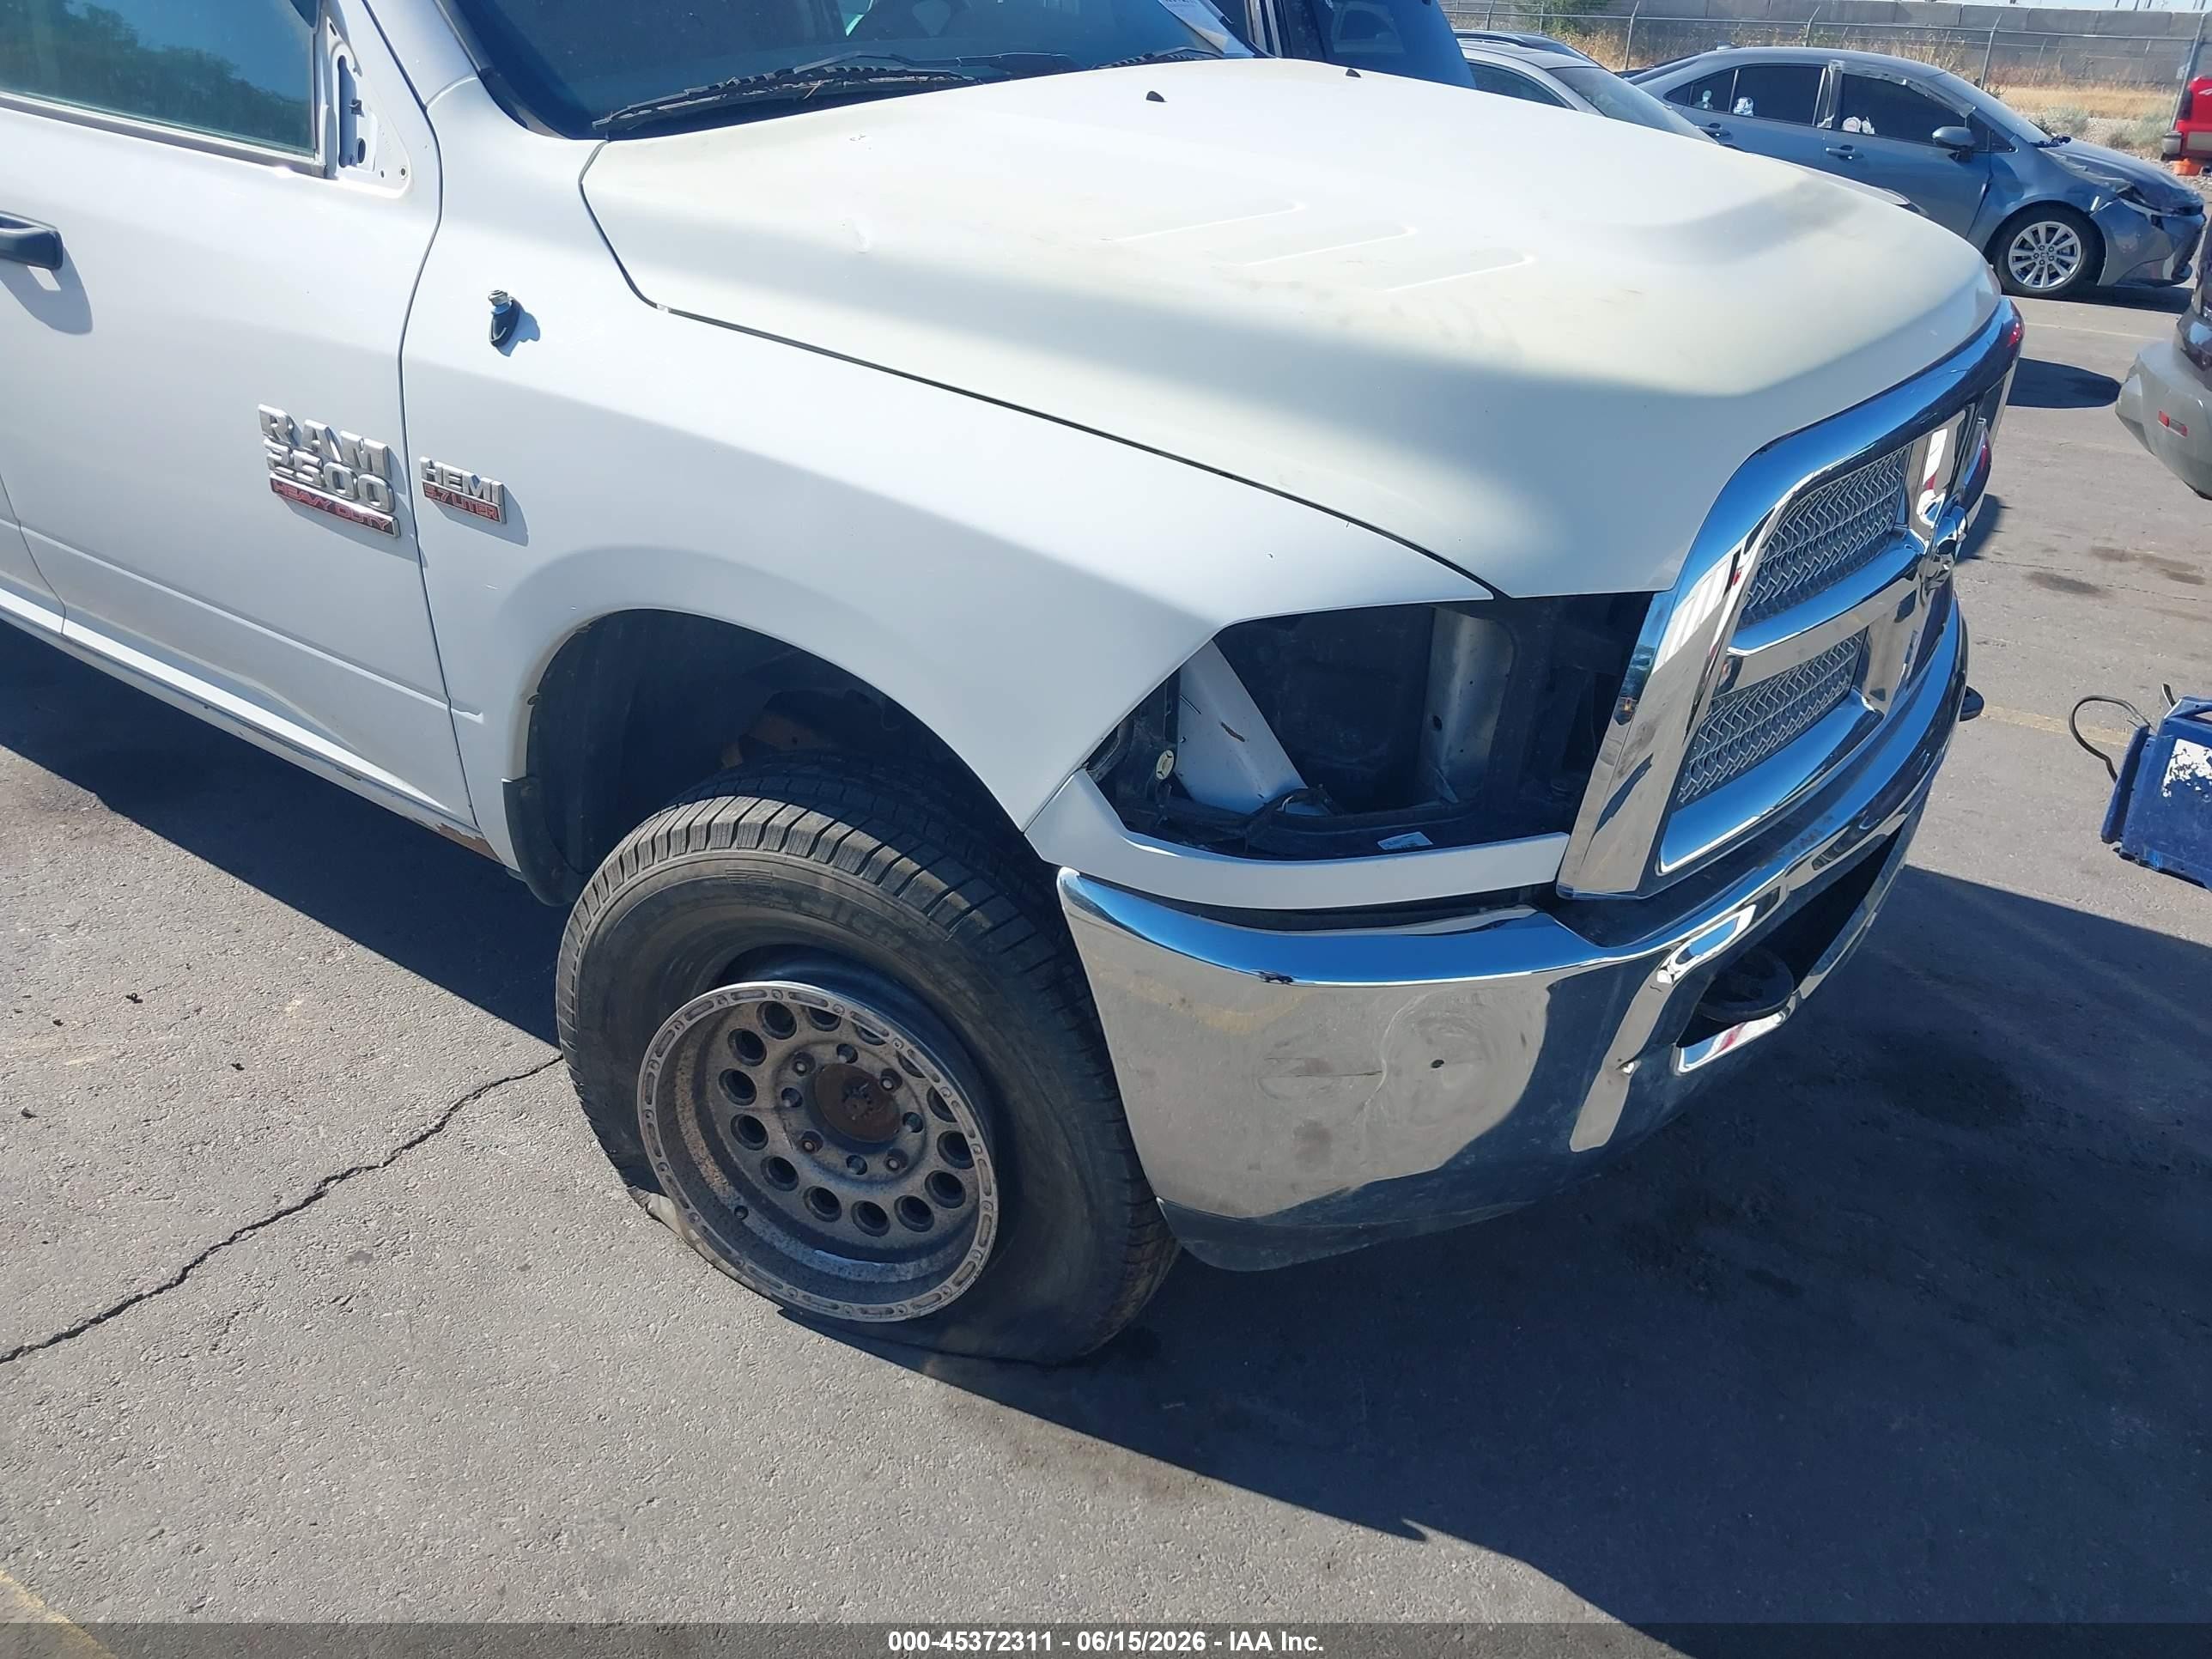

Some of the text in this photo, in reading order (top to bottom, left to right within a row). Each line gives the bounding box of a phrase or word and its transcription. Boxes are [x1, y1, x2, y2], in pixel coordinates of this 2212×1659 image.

[258, 404, 392, 477] RAM
[263, 438, 395, 513] 2500
[419, 456, 505, 505] HEMI
[424, 483, 499, 520] 5.7 LITER
[272, 478, 390, 531] HEAVY DUTY
